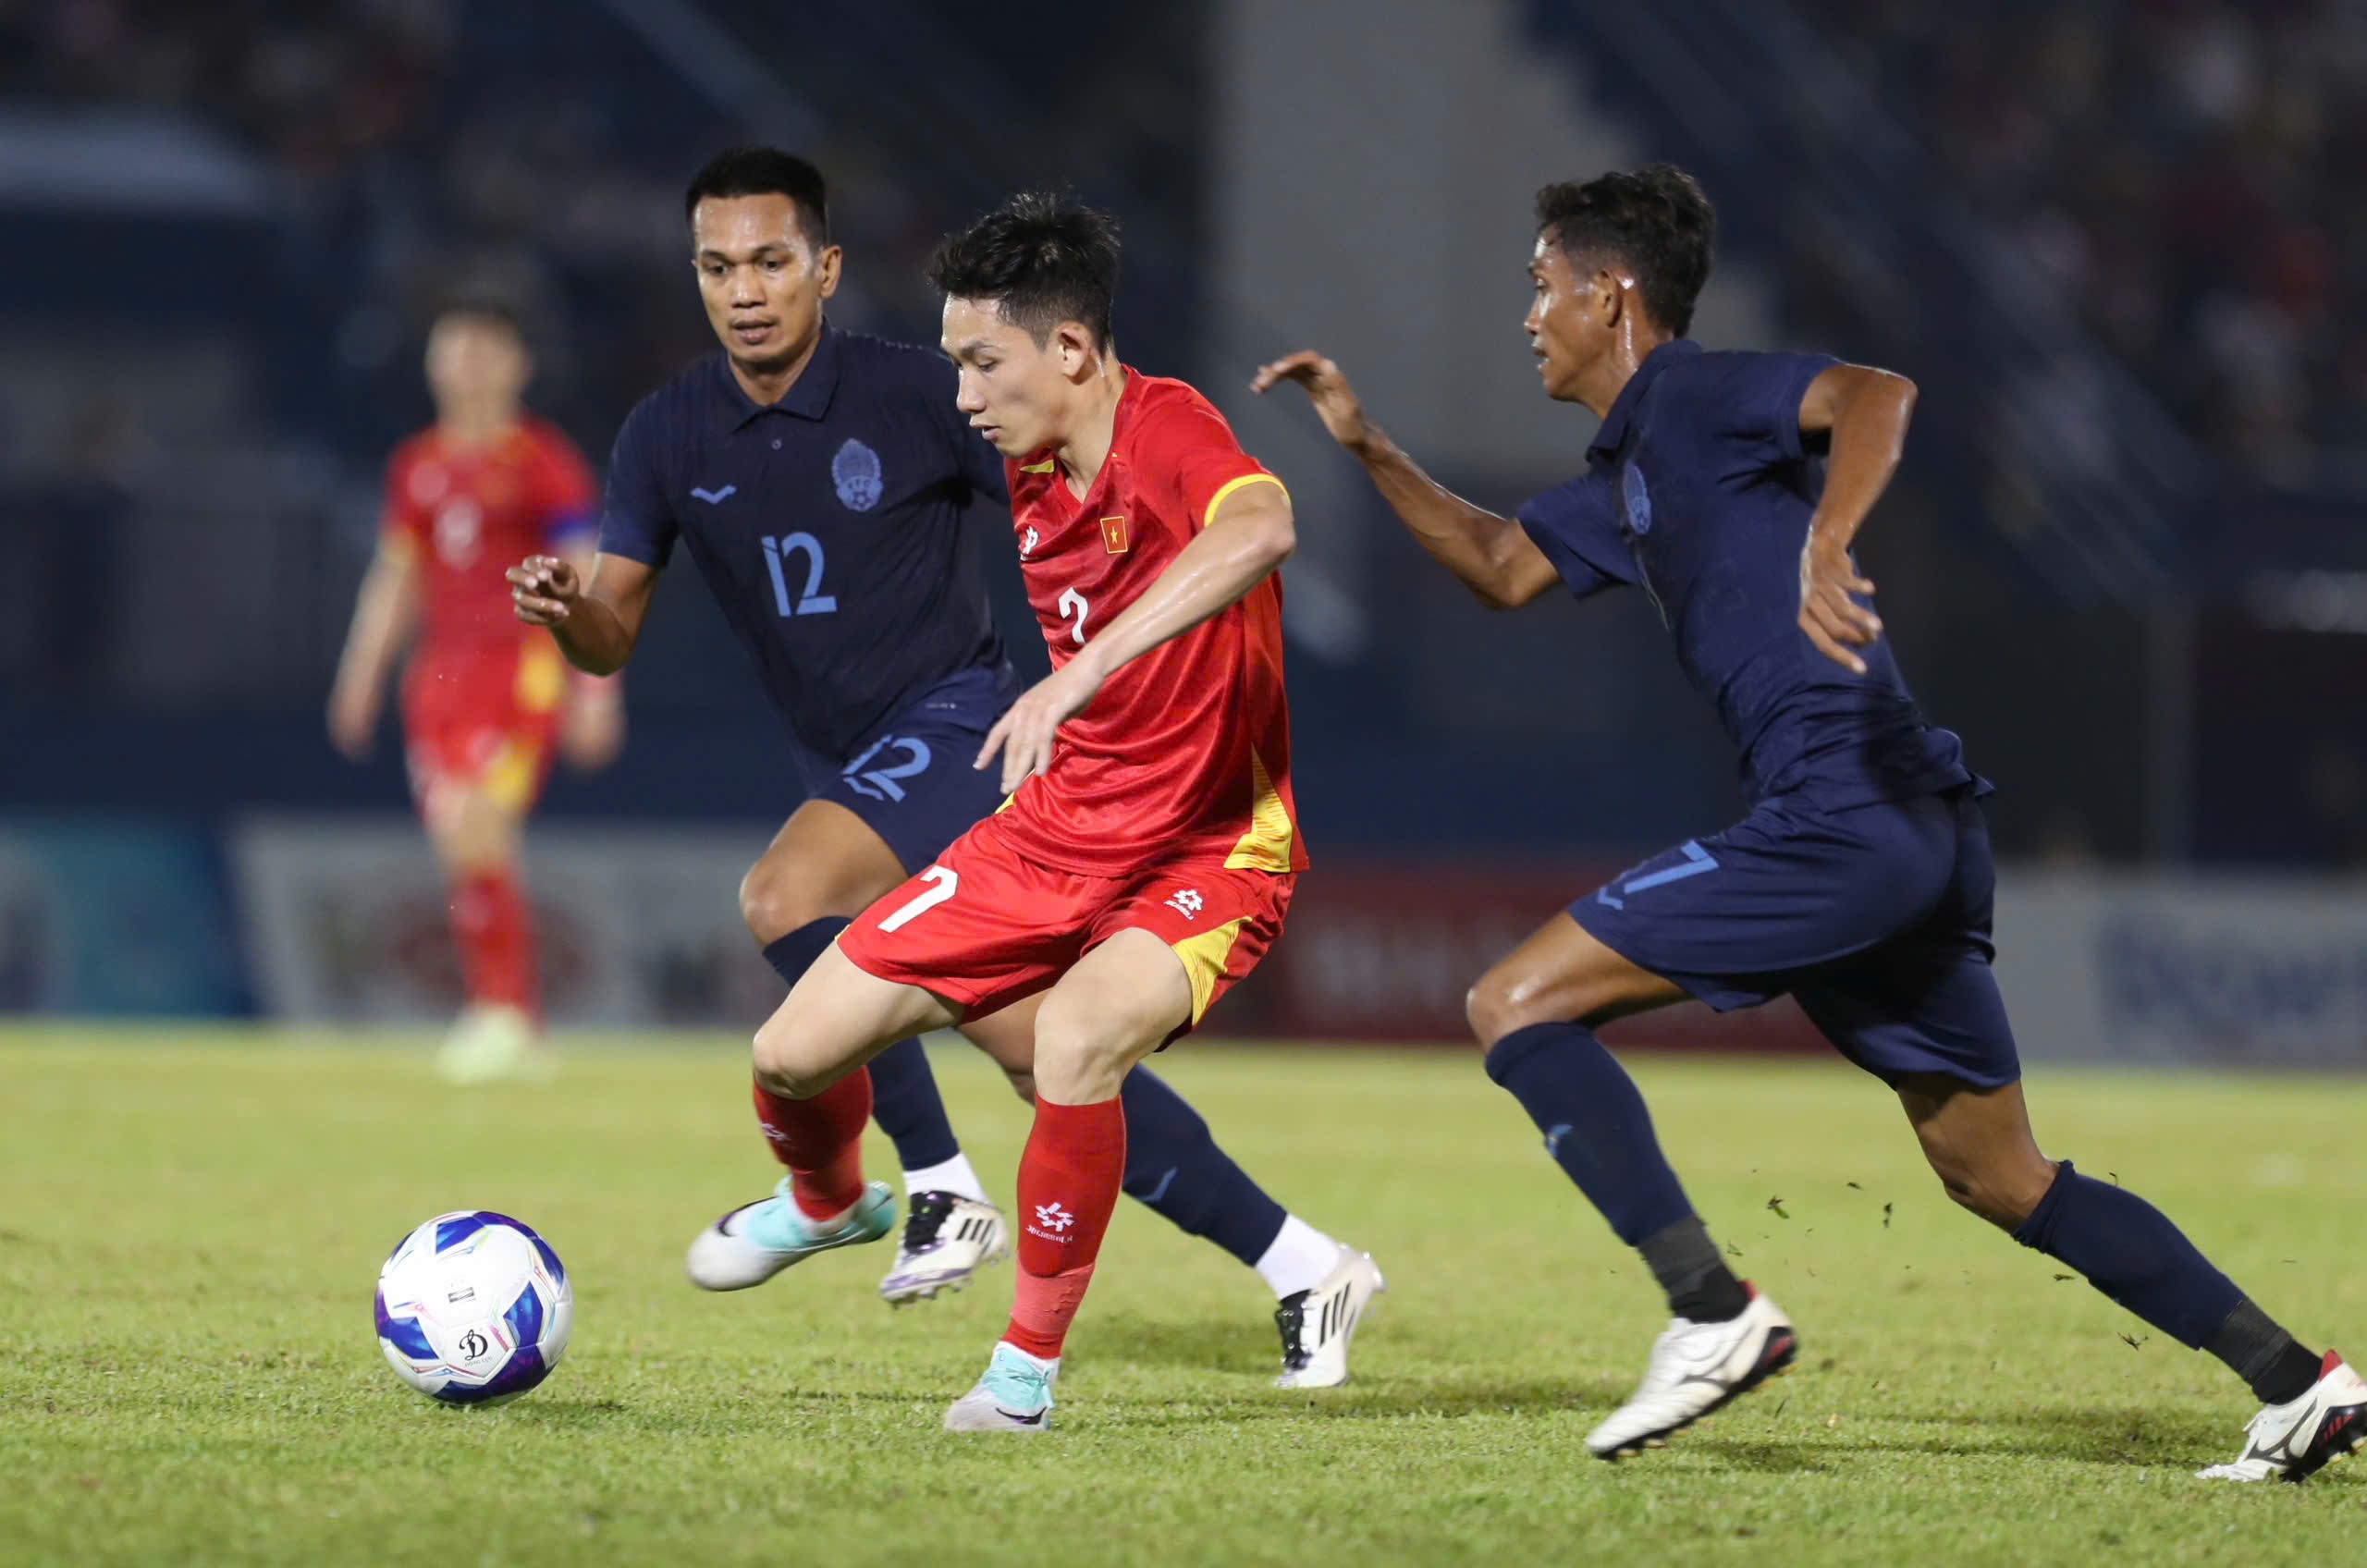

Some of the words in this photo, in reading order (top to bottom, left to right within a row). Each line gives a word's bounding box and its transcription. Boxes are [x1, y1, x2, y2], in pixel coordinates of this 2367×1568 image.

[761, 532, 837, 618] 12
[840, 734, 931, 802] 12
[878, 864, 958, 933] 7
[1625, 839, 1720, 894] 7
